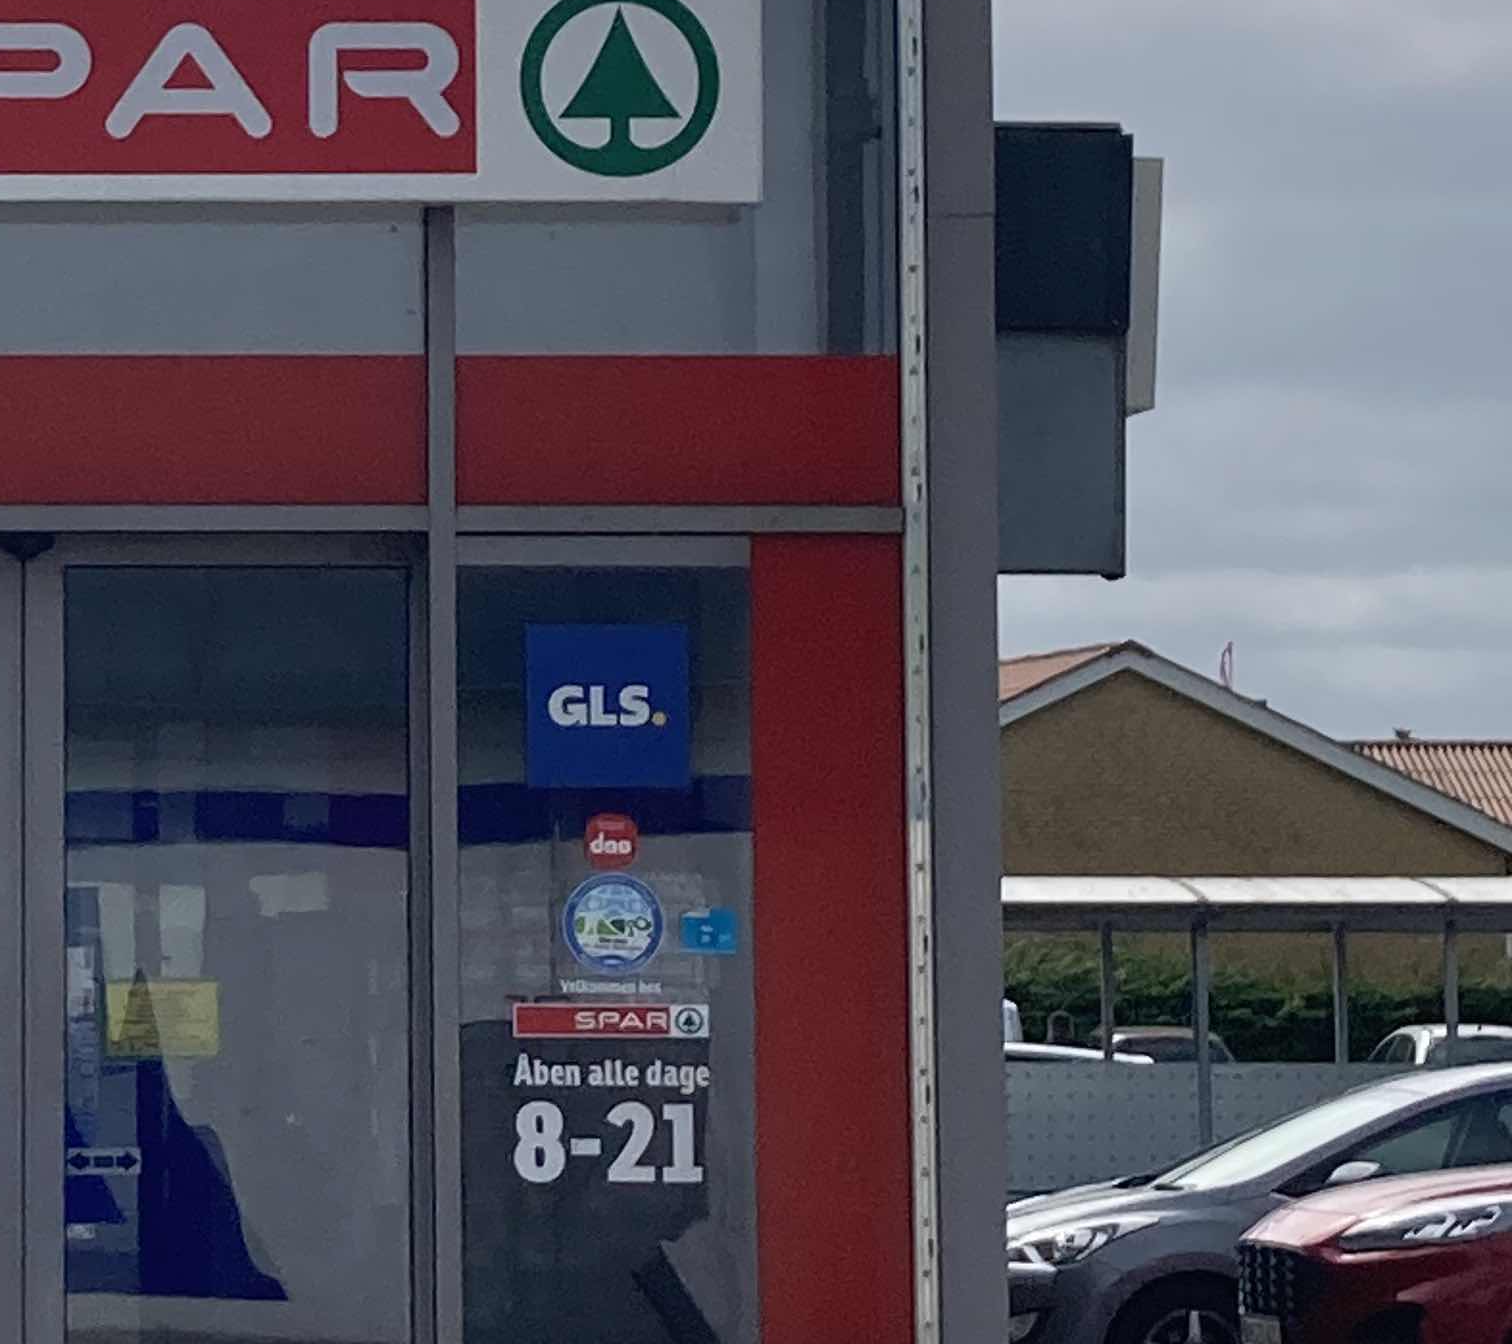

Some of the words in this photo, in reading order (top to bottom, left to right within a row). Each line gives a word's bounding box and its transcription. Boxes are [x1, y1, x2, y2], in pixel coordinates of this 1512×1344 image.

[574, 1011, 668, 1031] SPAR
[513, 1053, 582, 1087] Åben
[588, 1059, 640, 1087] alle
[645, 1059, 711, 1094] dage
[513, 1100, 705, 1184] 8-21
